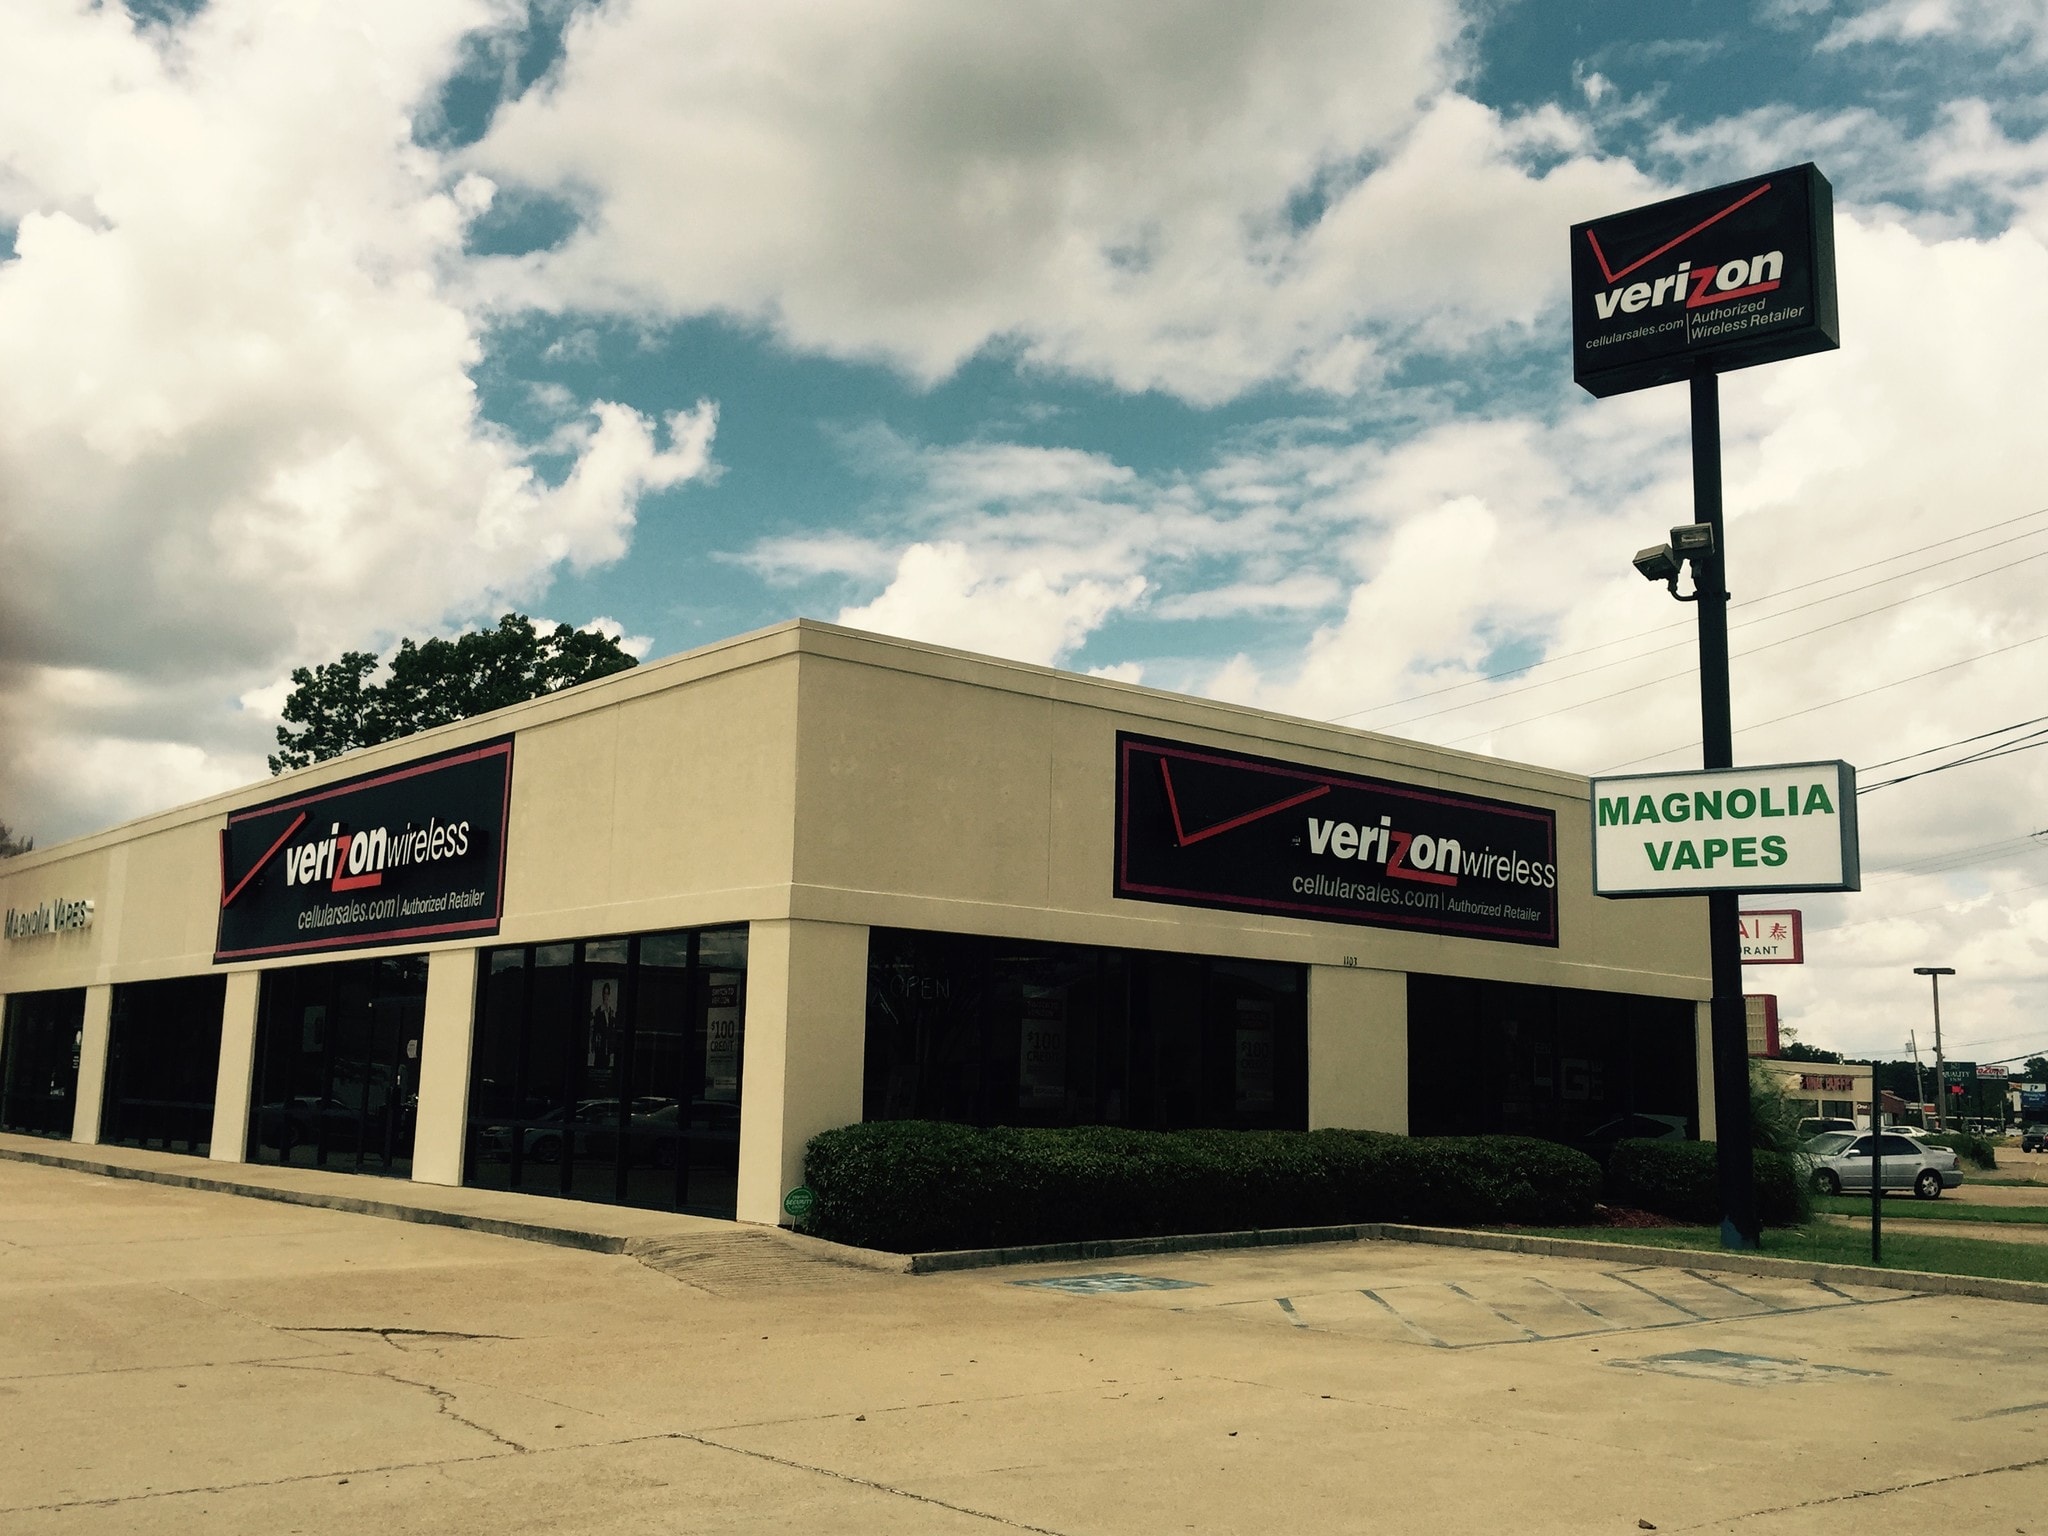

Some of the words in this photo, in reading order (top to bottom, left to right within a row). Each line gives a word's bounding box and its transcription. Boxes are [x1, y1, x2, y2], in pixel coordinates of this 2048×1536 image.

[1594, 250, 1784, 320] verizon
[1691, 298, 1766, 325] Authorized
[1691, 318, 1748, 340] Wireless
[1750, 306, 1805, 327] Retailer
[1585, 318, 1684, 349] cellularsales.com
[1598, 784, 1835, 826] MAGNOLIA
[1644, 836, 1788, 871] VAPES
[401, 893, 447, 916] Authorized
[448, 888, 485, 910] Retailer
[1292, 873, 1439, 909] cellularsales.com
[298, 897, 395, 929] cellularsales.com
[1447, 897, 1501, 917] Authorized
[1504, 904, 1541, 921] Retailer
[1740, 946, 1778, 955] RANT
[889, 975, 950, 999] OPEN
[711, 1020, 735, 1039] $100
[1027, 1031, 1060, 1050] $100
[710, 1040, 735, 1052] CREDIT
